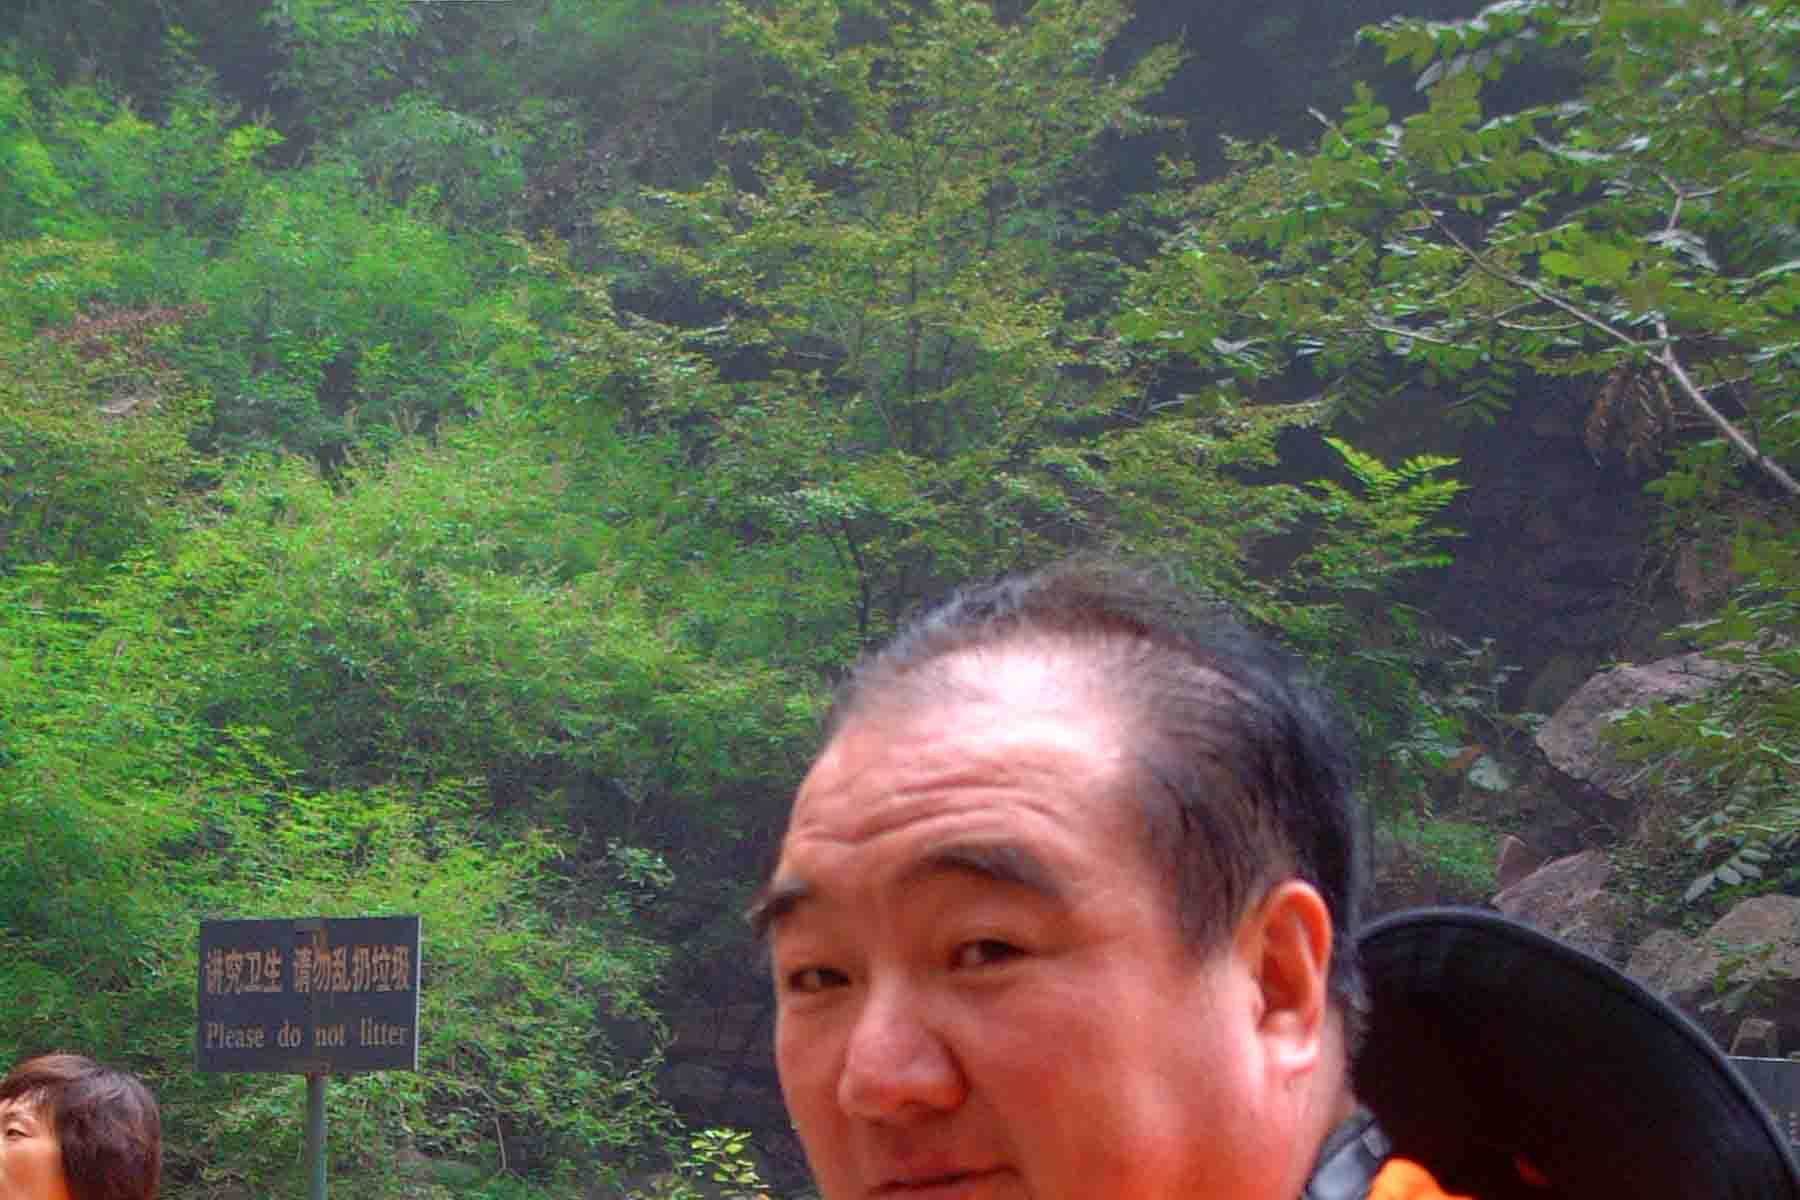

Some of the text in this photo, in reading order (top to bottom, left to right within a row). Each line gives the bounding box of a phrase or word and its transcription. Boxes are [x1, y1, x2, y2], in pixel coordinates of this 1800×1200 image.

[205, 1016, 408, 1048] Please do not litter
